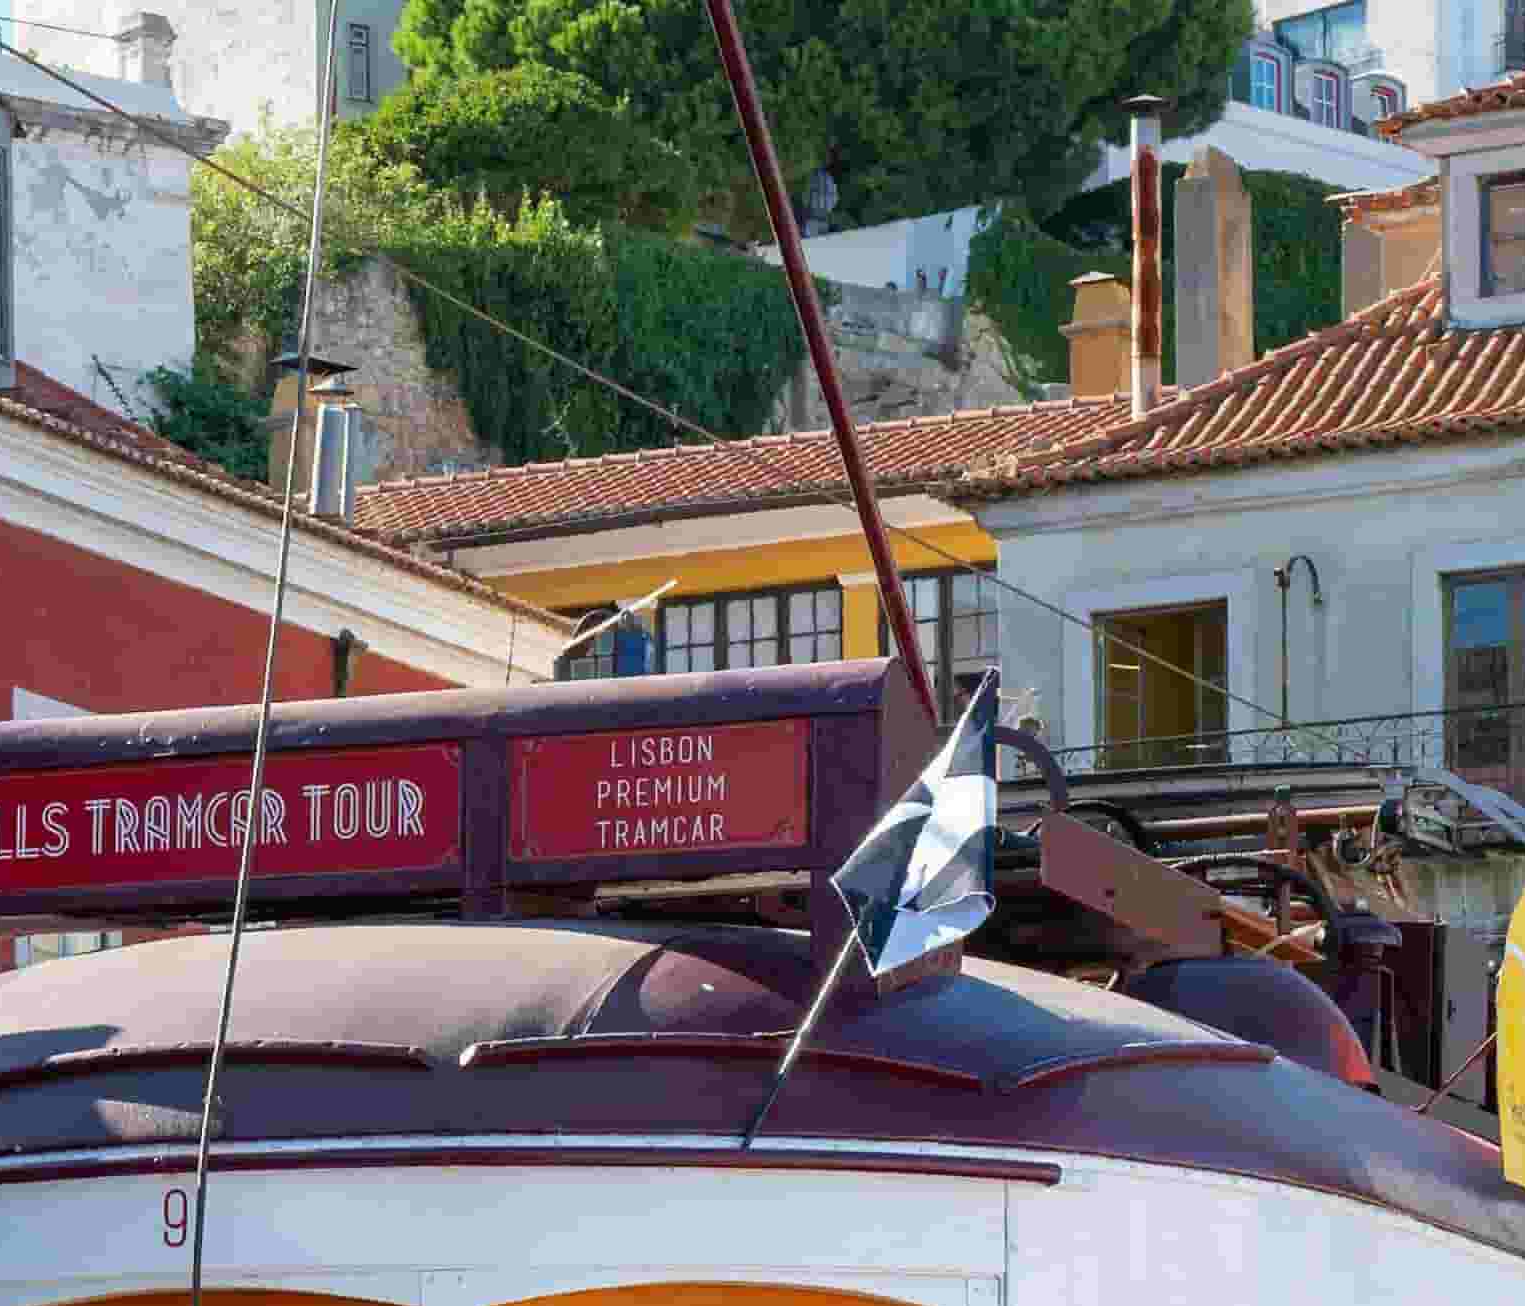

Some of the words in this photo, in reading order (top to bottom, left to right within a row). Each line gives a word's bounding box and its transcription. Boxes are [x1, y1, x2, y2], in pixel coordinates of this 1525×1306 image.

[610, 735, 714, 768] LISBON
[596, 773, 727, 809] PREMIUM
[83, 788, 289, 856] TRAMCAR
[301, 776, 427, 842] TOUR
[594, 812, 724, 849] TRAMCAR
[163, 1189, 188, 1249] 9
